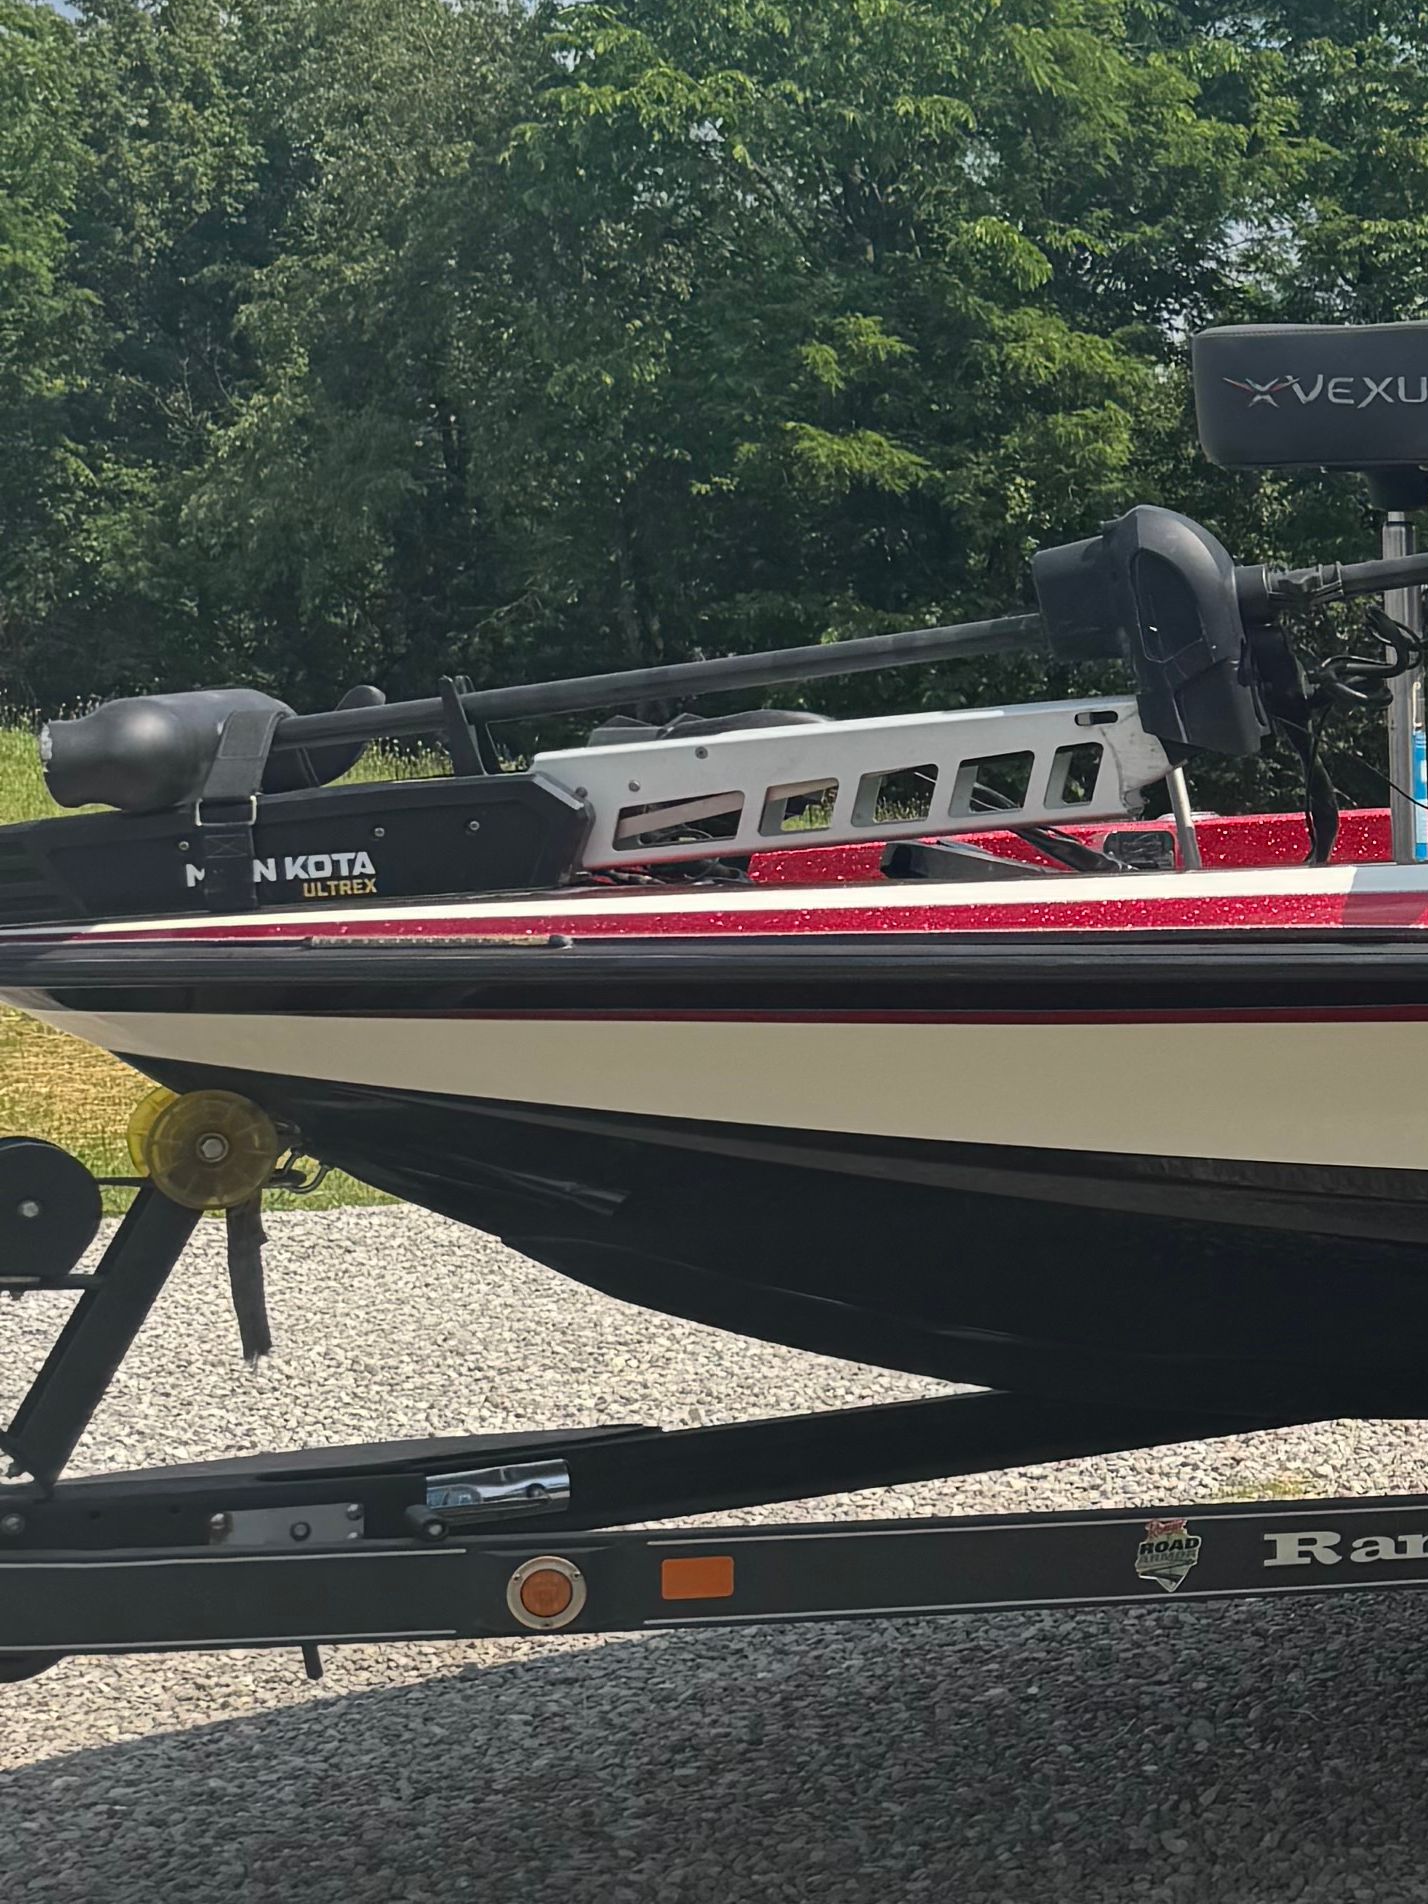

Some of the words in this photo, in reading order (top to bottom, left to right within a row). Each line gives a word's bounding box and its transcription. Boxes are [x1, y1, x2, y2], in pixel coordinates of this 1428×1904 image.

[185, 857, 278, 888] MN
[284, 851, 377, 881] KOTA
[302, 877, 378, 898] ULTREX
[1139, 1537, 1200, 1555] ROAD
